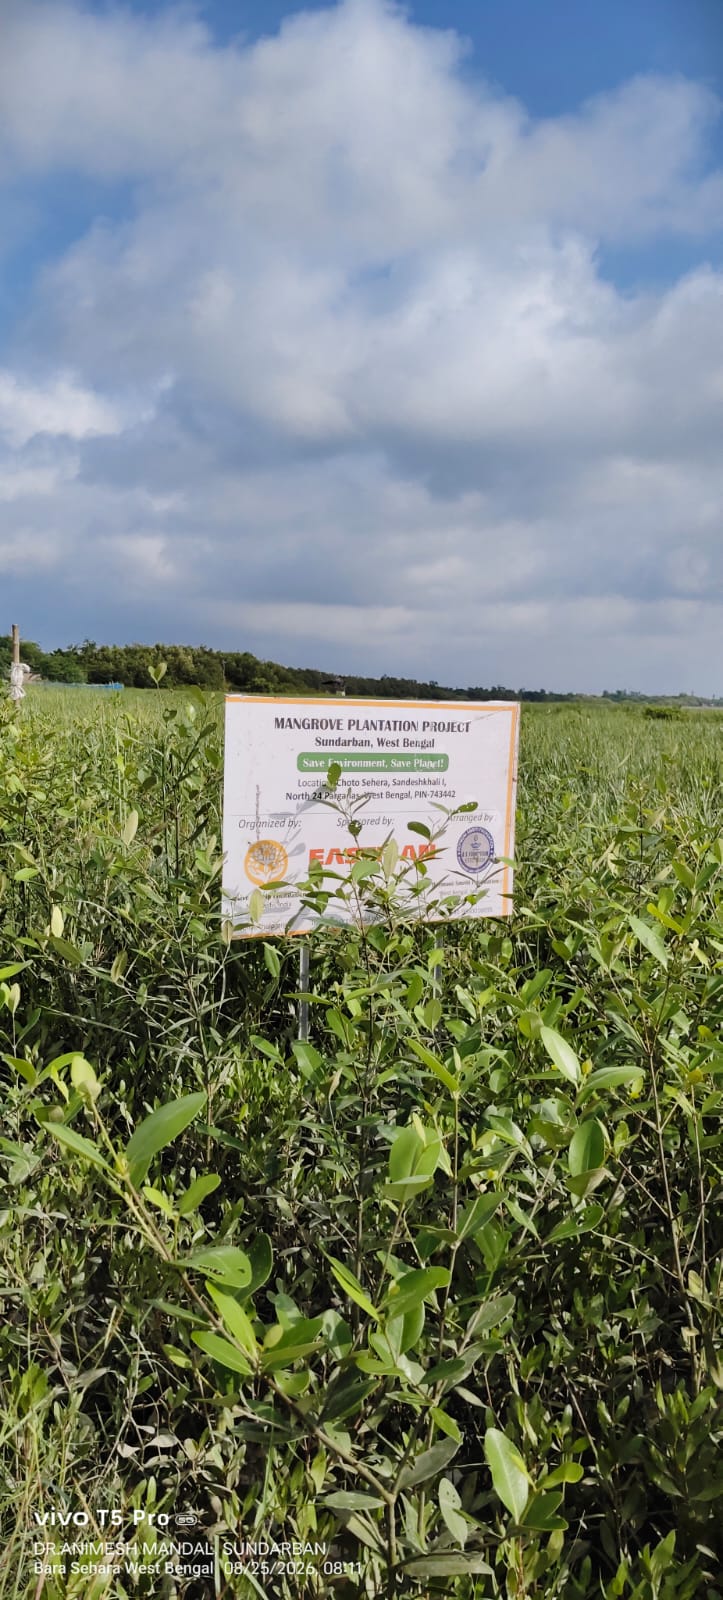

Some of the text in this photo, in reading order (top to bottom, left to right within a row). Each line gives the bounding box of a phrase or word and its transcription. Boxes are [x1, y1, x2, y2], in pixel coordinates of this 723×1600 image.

[274, 717, 471, 733] MANGROVE PLANTATION PROJECT
[314, 736, 435, 750] Sundarban, West Bengal
[302, 758, 325, 768] Save
[390, 758, 411, 768] Save
[413, 758, 444, 768] Planet!
[336, 778, 360, 787] Choto
[361, 778, 390, 788] Sehera,
[392, 777, 440, 787] Sandeshkhali
[285, 791, 310, 801] North
[312, 791, 322, 801] 24
[385, 790, 413, 801] Bengal,
[414, 789, 456, 800] PIN-743442
[238, 818, 302, 831] Organized by:
[336, 814, 395, 828] Spored by:
